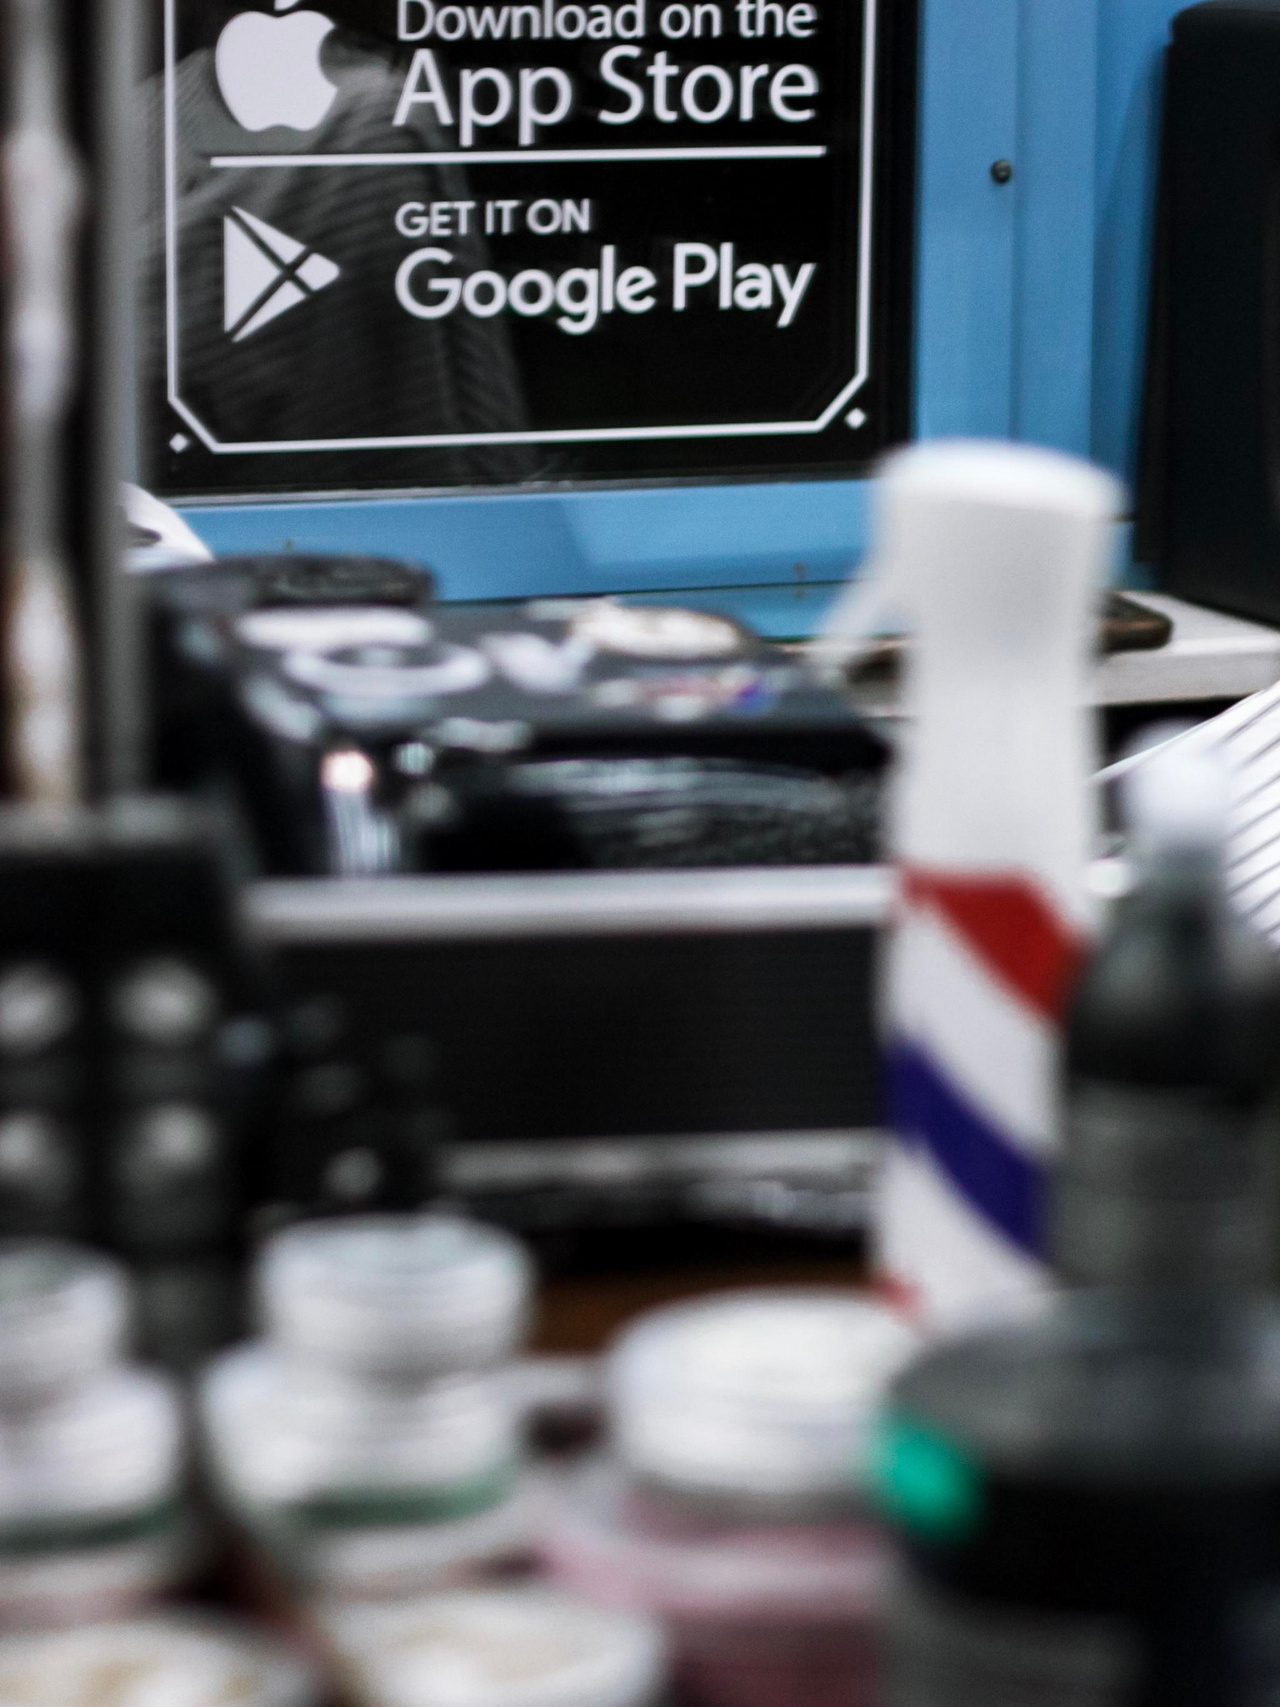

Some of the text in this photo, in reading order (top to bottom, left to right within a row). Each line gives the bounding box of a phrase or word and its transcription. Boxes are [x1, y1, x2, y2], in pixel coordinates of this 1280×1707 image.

[397, 0, 818, 41] Download on the
[392, 45, 819, 147] App Store
[395, 198, 591, 237] GET IT ON
[395, 242, 817, 335] Google Play
